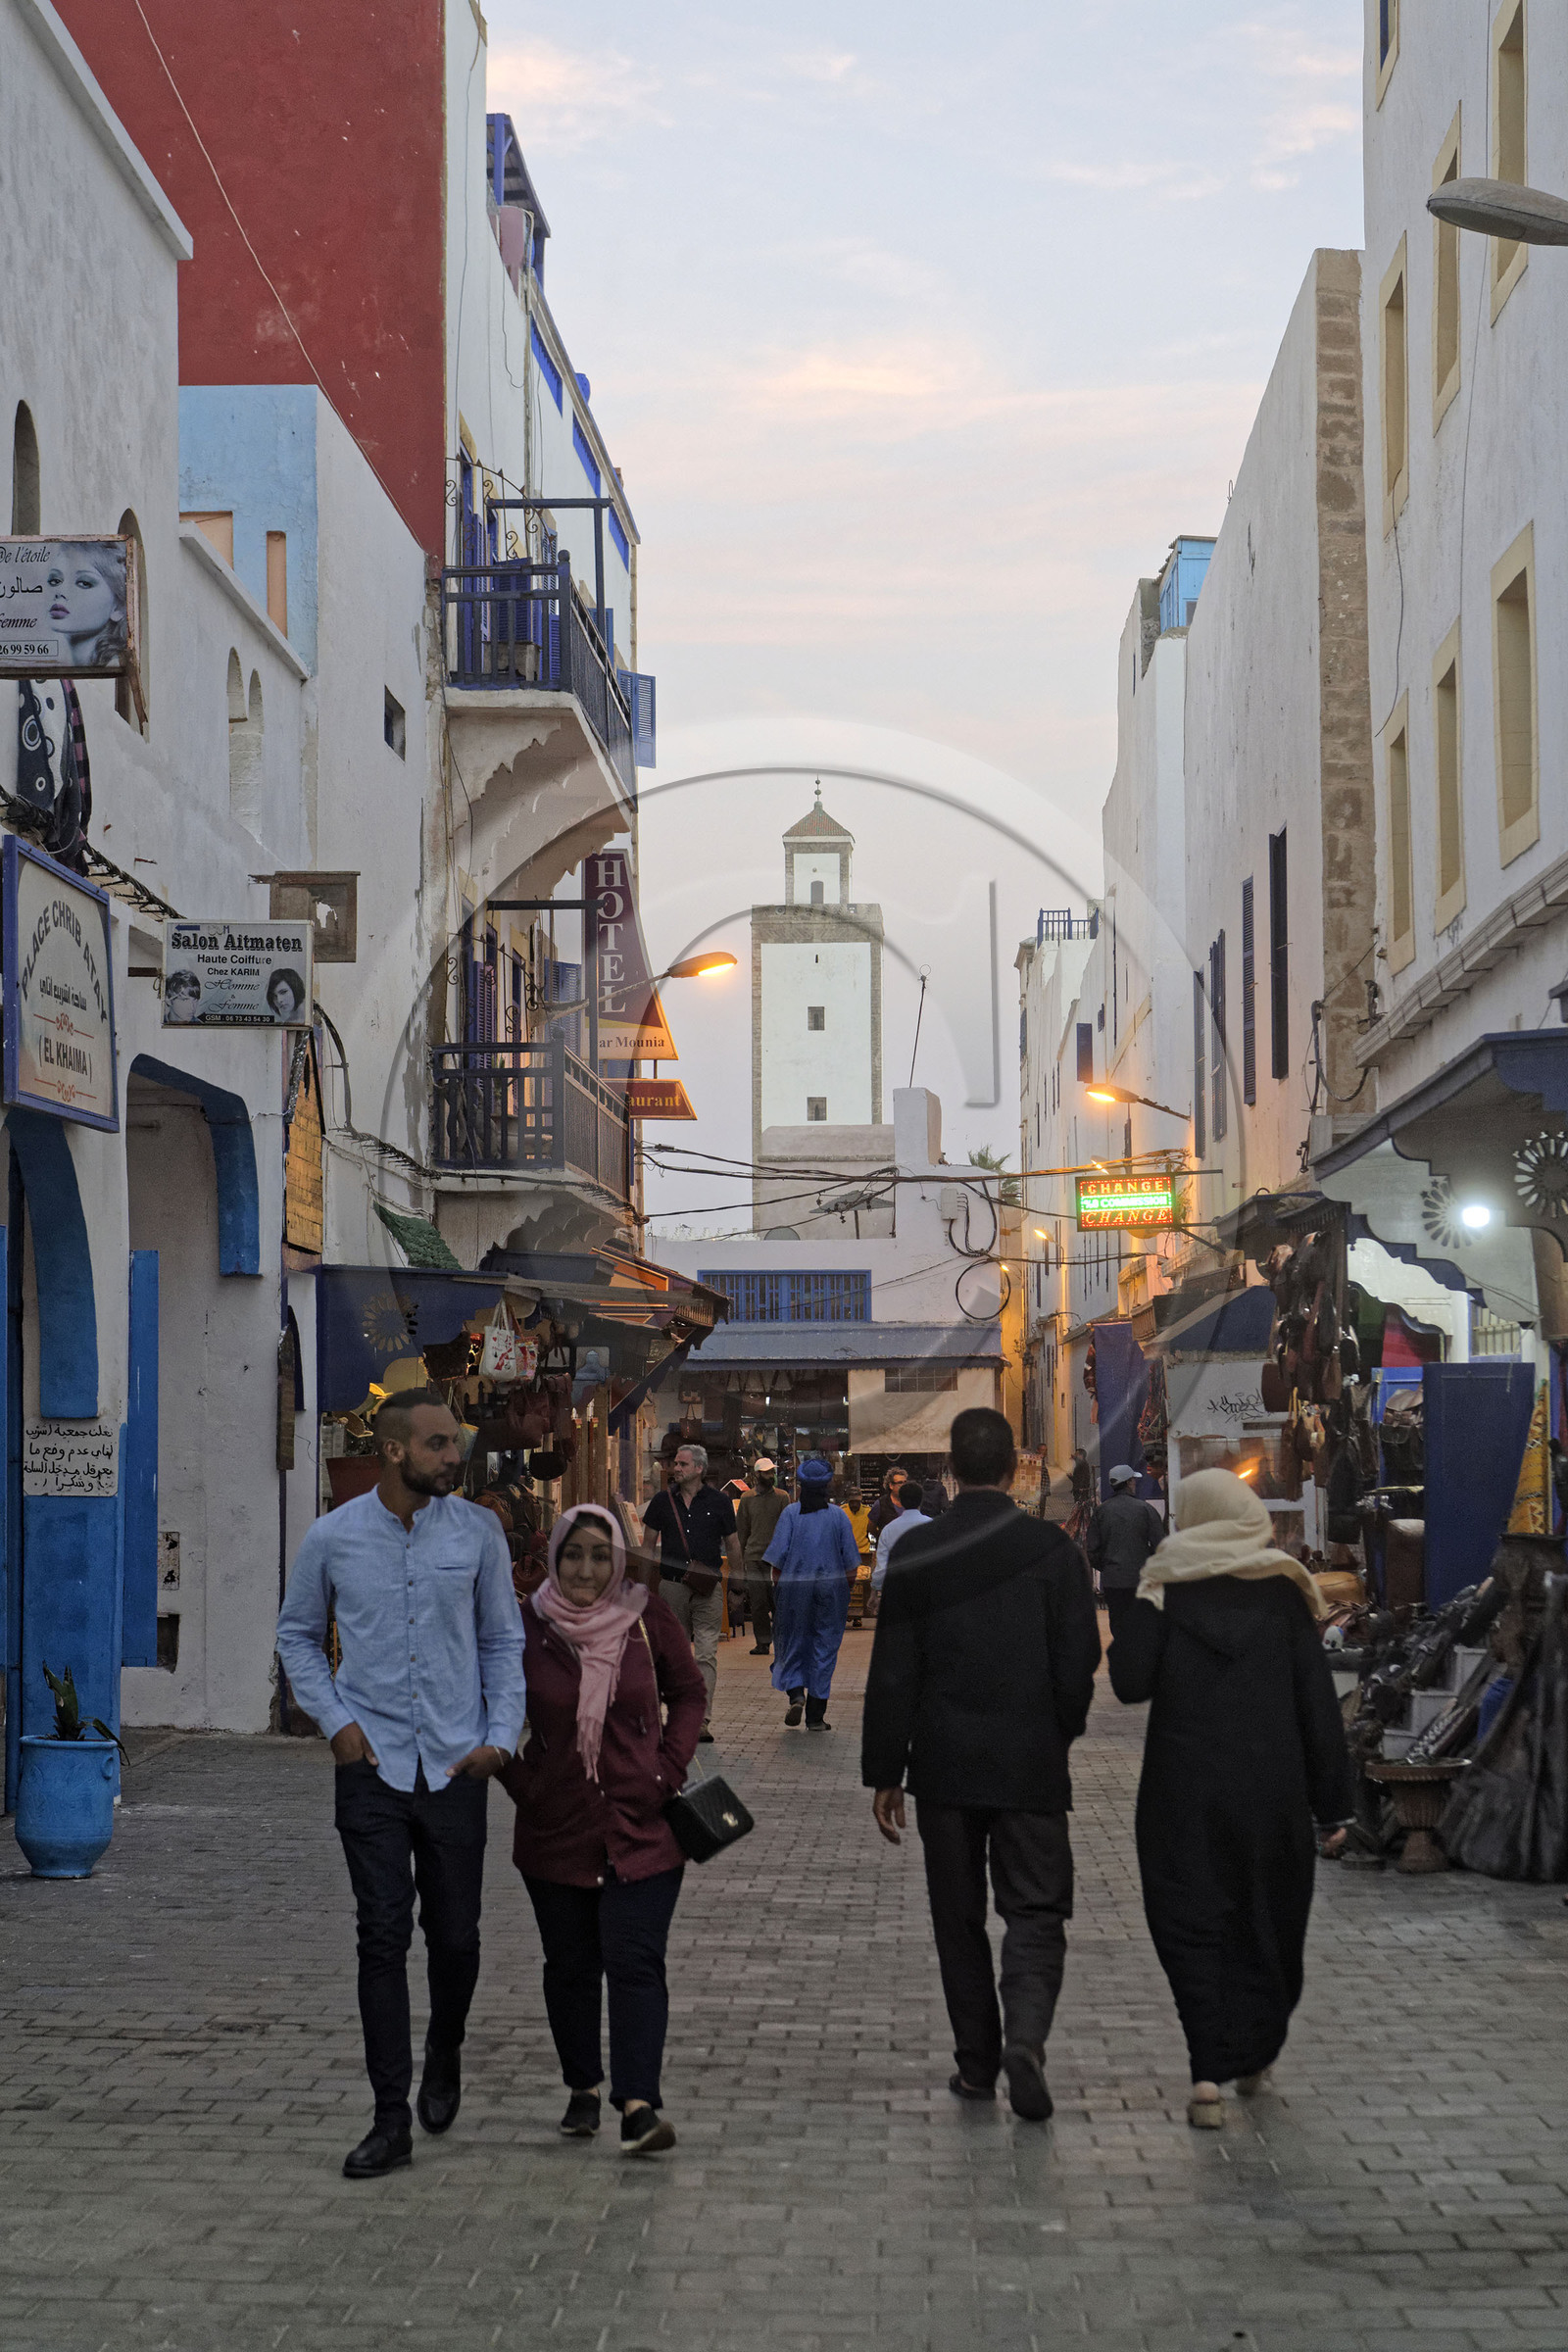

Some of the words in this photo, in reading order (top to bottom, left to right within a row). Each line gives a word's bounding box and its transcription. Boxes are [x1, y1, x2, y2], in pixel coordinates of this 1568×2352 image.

[15, 546, 50, 563] l'étoile
[11, 644, 22, 655] 99
[24, 644, 35, 655] 59
[37, 644, 49, 655] 66
[172, 932, 220, 951] Salon
[223, 934, 303, 952] Aitmaten
[594, 859, 626, 1013] HOTEL
[22, 906, 51, 1003] PLACE
[52, 900, 81, 948] CHRIB
[197, 955, 227, 964] Haute
[230, 955, 272, 965] Coiffure
[207, 967, 228, 976] Chez
[204, 978, 261, 991] Homme
[599, 1039, 612, 1048] ar
[615, 1036, 664, 1048] Mounia
[628, 1095, 681, 1106] aurant
[1087, 1180, 1164, 1195] CHANGE
[1101, 1195, 1168, 1208] COMMISSION
[1085, 1208, 1169, 1224] CHANGE
[68, 1447, 89, 1462] عدم
